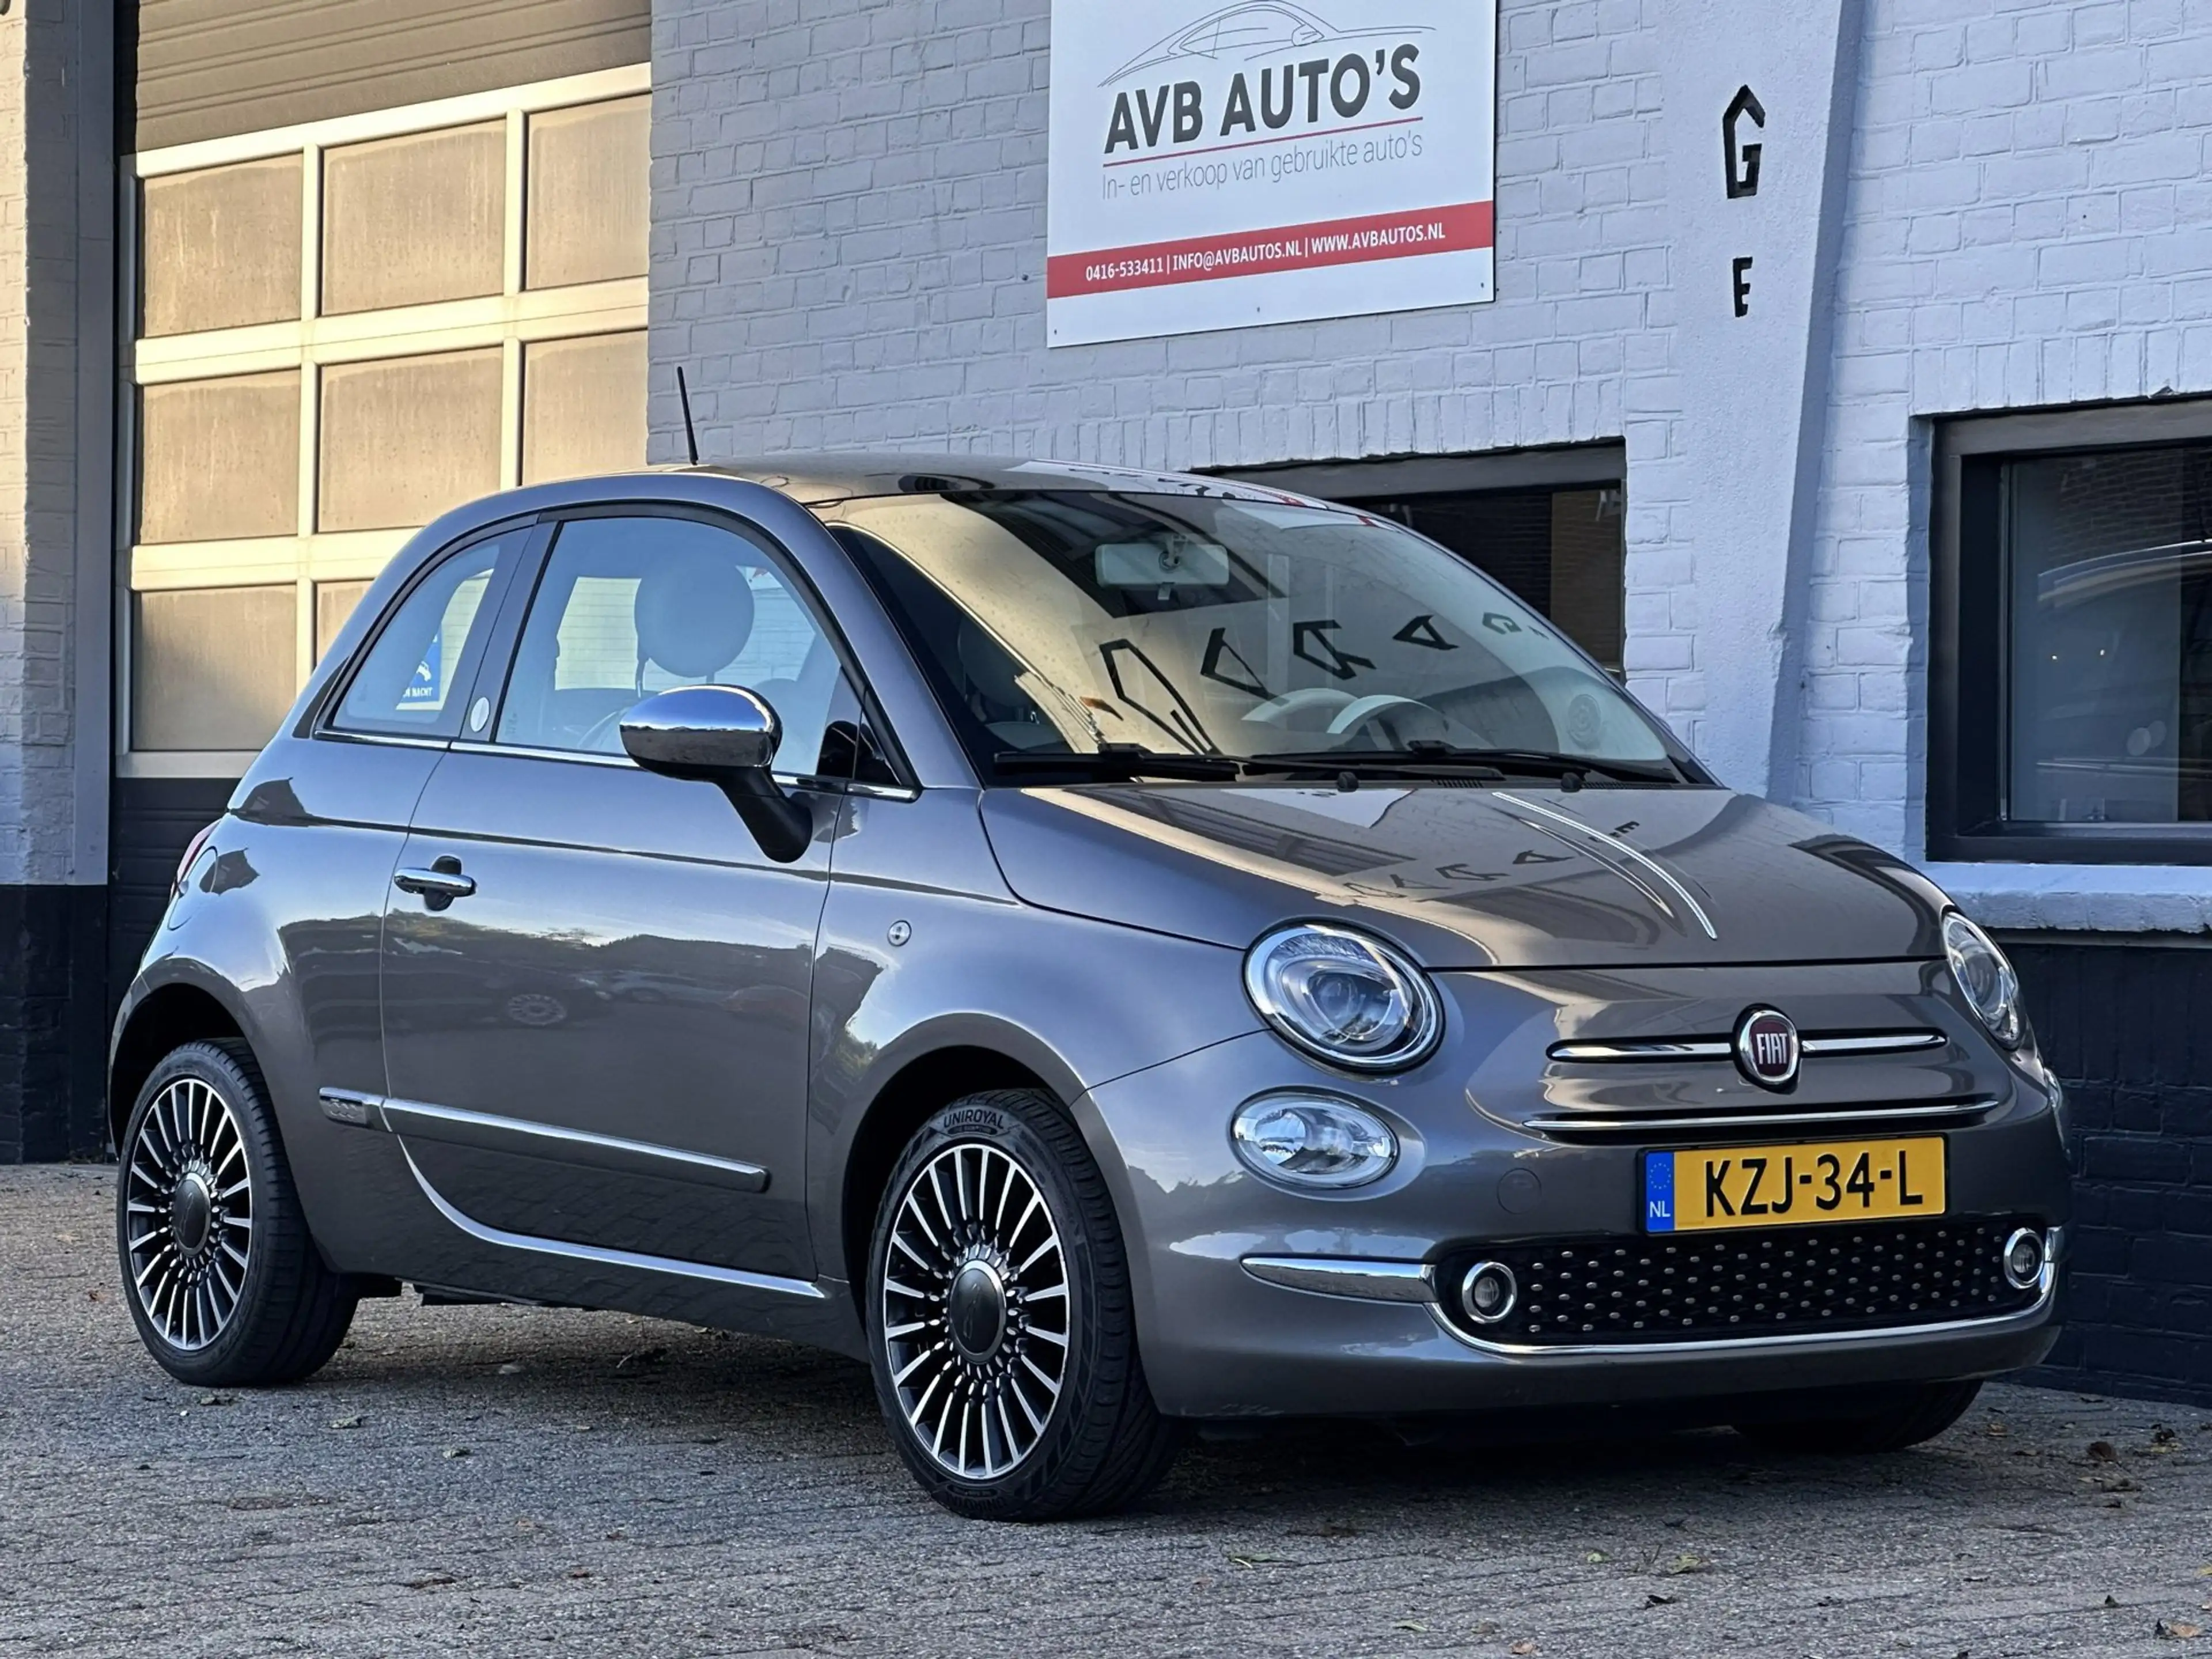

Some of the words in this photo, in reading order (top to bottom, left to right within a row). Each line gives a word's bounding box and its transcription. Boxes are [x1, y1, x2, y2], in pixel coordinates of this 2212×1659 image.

[1104, 81, 1202, 153] AVB
[1219, 44, 1421, 136] AUTO'S
[1103, 174, 1125, 199] In-
[1130, 173, 1150, 195] en
[1156, 161, 1228, 191] verkoop
[1233, 156, 1265, 180] van
[1271, 139, 1357, 183] gebruikte
[1363, 131, 1422, 164] auto's
[1086, 257, 1163, 281] 0416-533411
[1173, 240, 1301, 272] INFO@AVBAUTOS.NL
[1311, 222, 1445, 254] WWW.AVBAUTOS.NL
[1756, 1033, 1787, 1065] FIAT
[944, 1109, 1004, 1129] UNIROYAL
[1649, 1200, 1671, 1218] NL
[1706, 1150, 1922, 1217] KZJ-34-L
